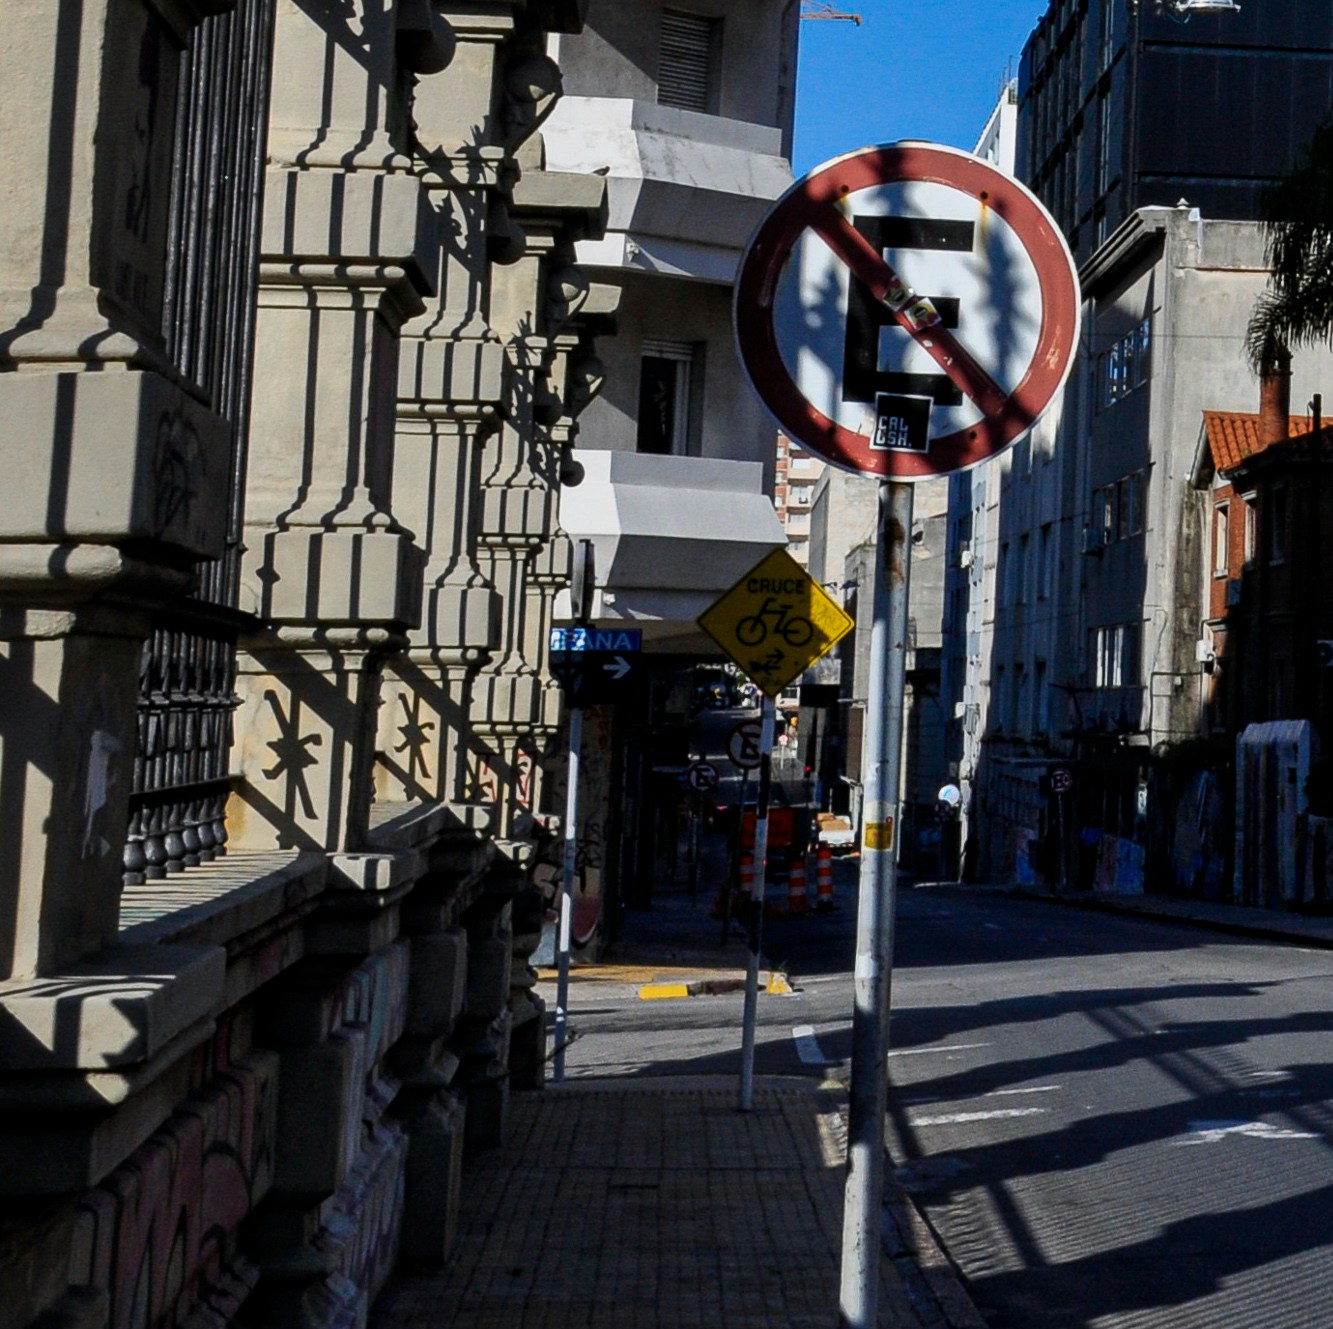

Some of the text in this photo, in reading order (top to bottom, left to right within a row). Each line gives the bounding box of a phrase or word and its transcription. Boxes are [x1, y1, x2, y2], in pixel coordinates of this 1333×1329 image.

[842, 215, 975, 405] E
[877, 416, 908, 431] CAL
[747, 577, 805, 595] CRUCE
